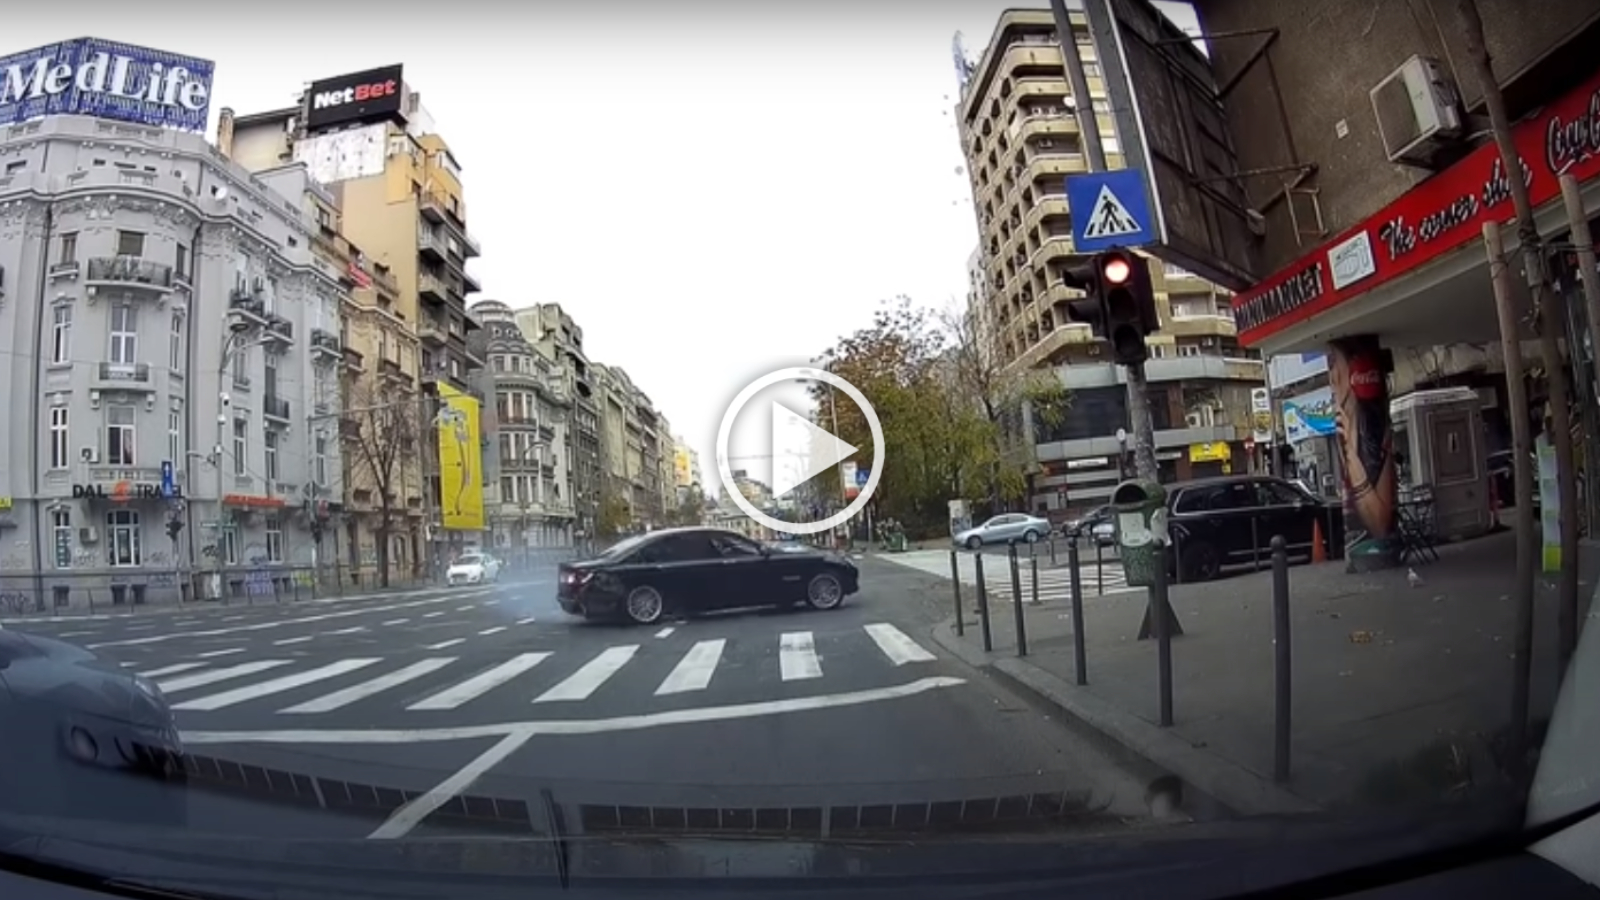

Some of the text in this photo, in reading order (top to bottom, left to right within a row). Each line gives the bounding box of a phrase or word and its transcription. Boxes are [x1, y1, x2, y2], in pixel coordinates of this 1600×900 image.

[2, 51, 209, 111] MedLife
[314, 79, 396, 110] NetBet
[1379, 215, 1416, 261] The
[1233, 262, 1323, 334] MINIMARKET
[73, 484, 185, 499] DAL TRAEL
